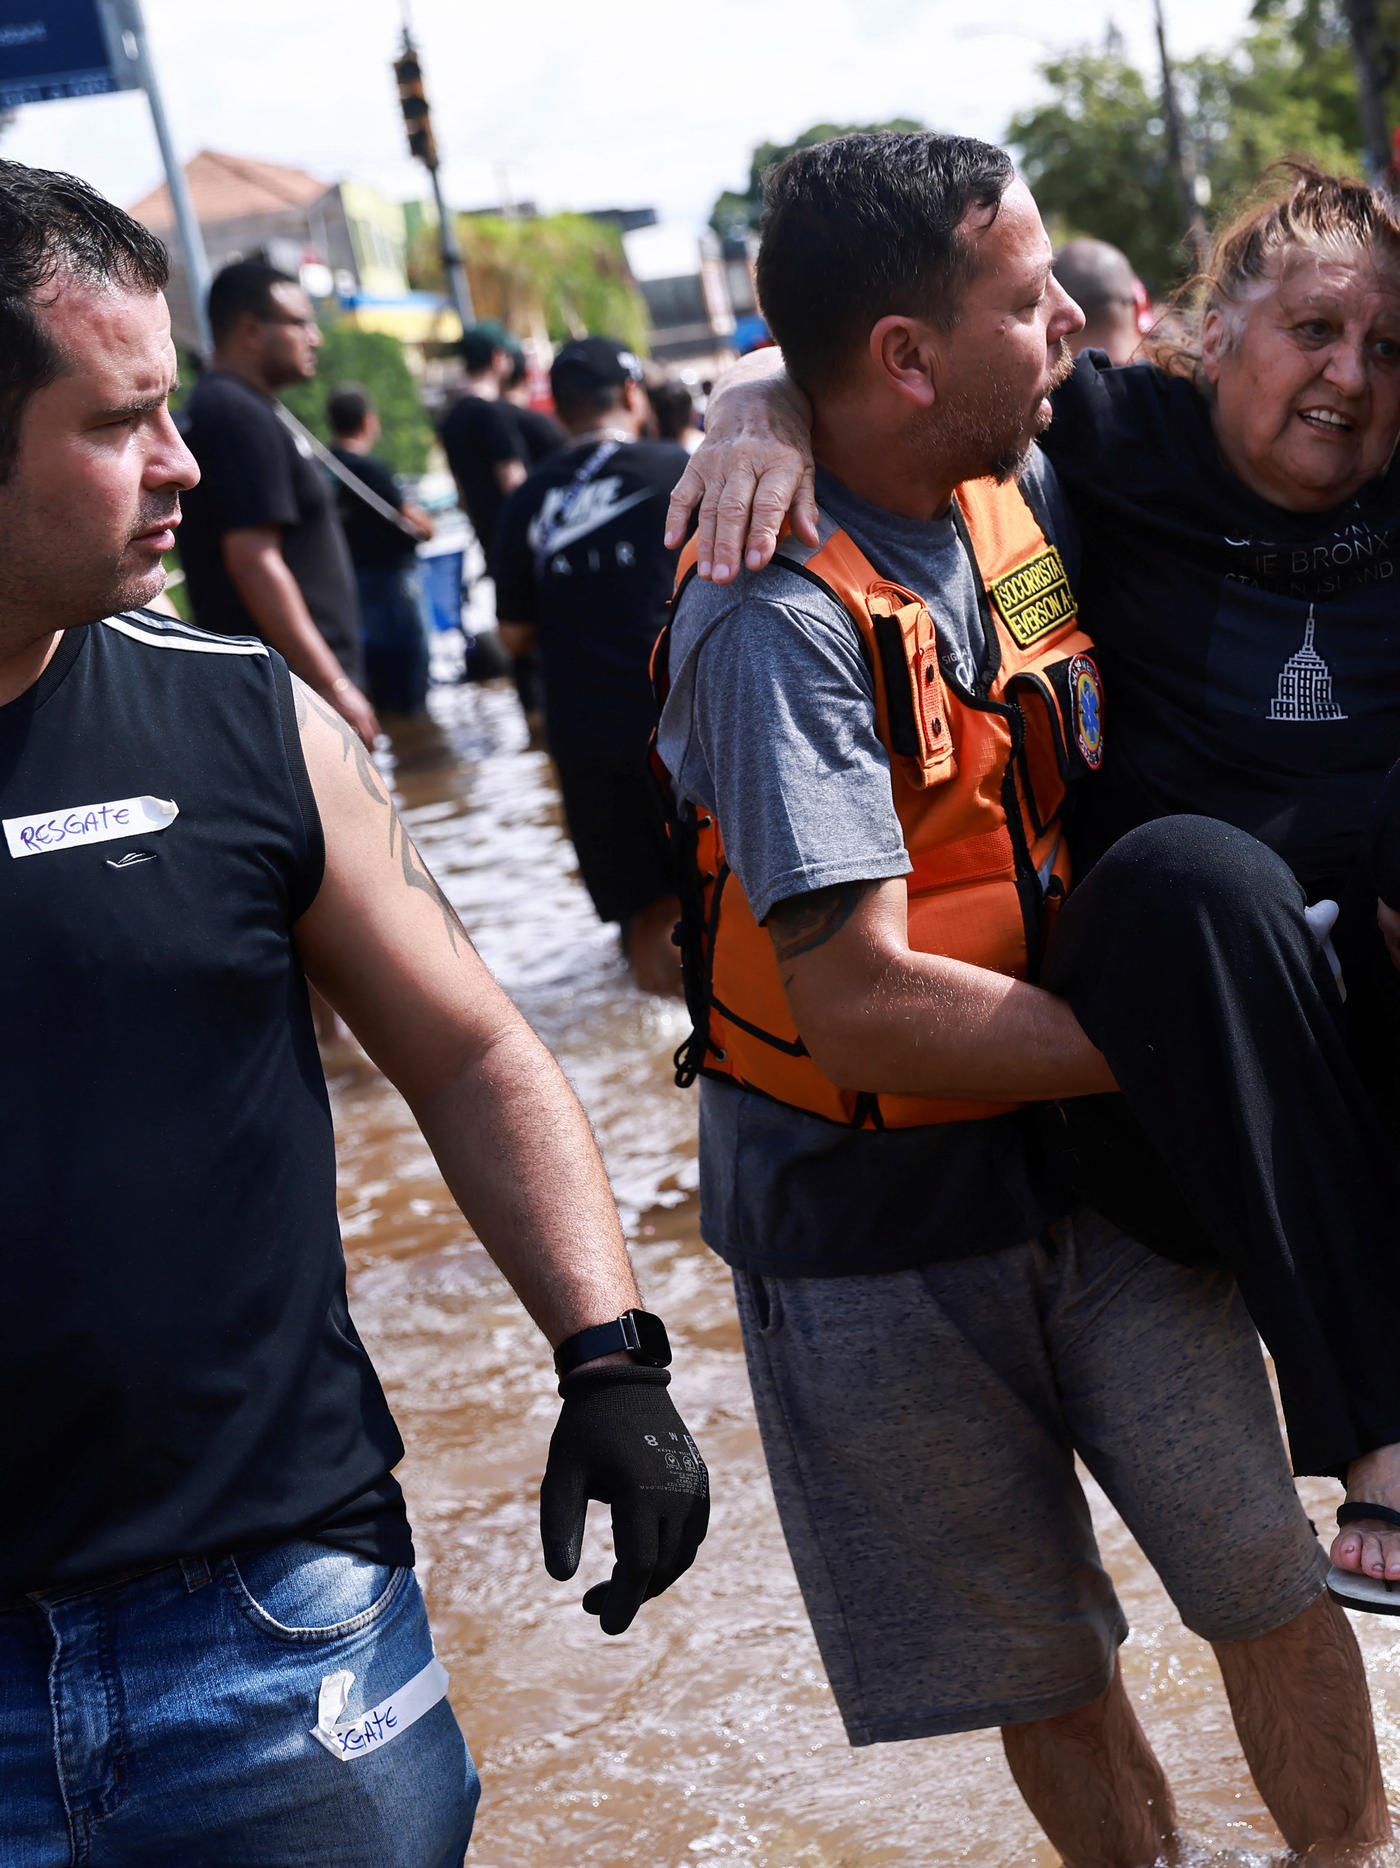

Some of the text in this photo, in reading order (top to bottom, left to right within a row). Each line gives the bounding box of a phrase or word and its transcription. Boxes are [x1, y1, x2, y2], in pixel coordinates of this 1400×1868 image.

[1291, 530, 1390, 574] BRONX
[998, 555, 1063, 609] SOCORRISTA
[1011, 592, 1064, 639] EVERSON
[20, 805, 130, 851] RESGATE
[644, 1434, 659, 1447] 8
